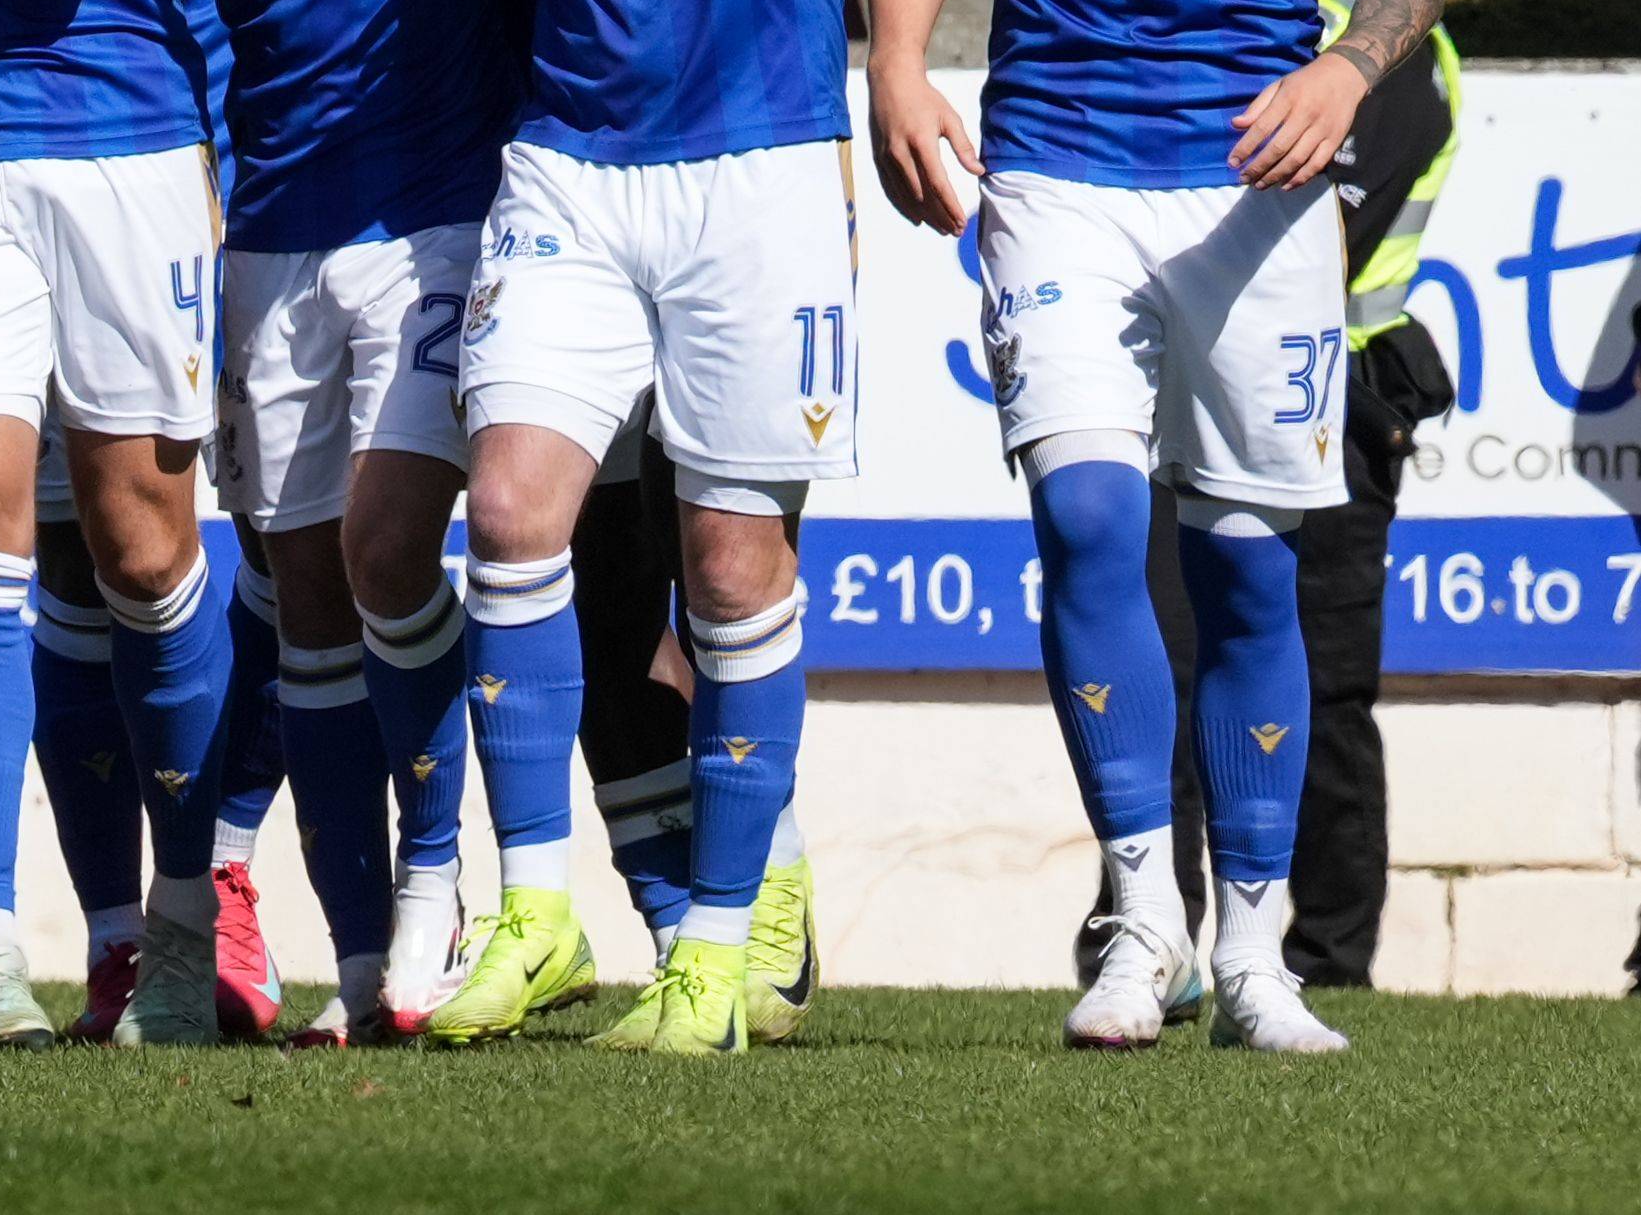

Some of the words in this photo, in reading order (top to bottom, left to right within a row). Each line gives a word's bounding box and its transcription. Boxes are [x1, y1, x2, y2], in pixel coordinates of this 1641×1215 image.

[170, 254, 204, 343] 4
[792, 304, 845, 397] 11
[1273, 327, 1342, 424] 37
[830, 553, 995, 634] £10,
[1509, 555, 1582, 625] to
